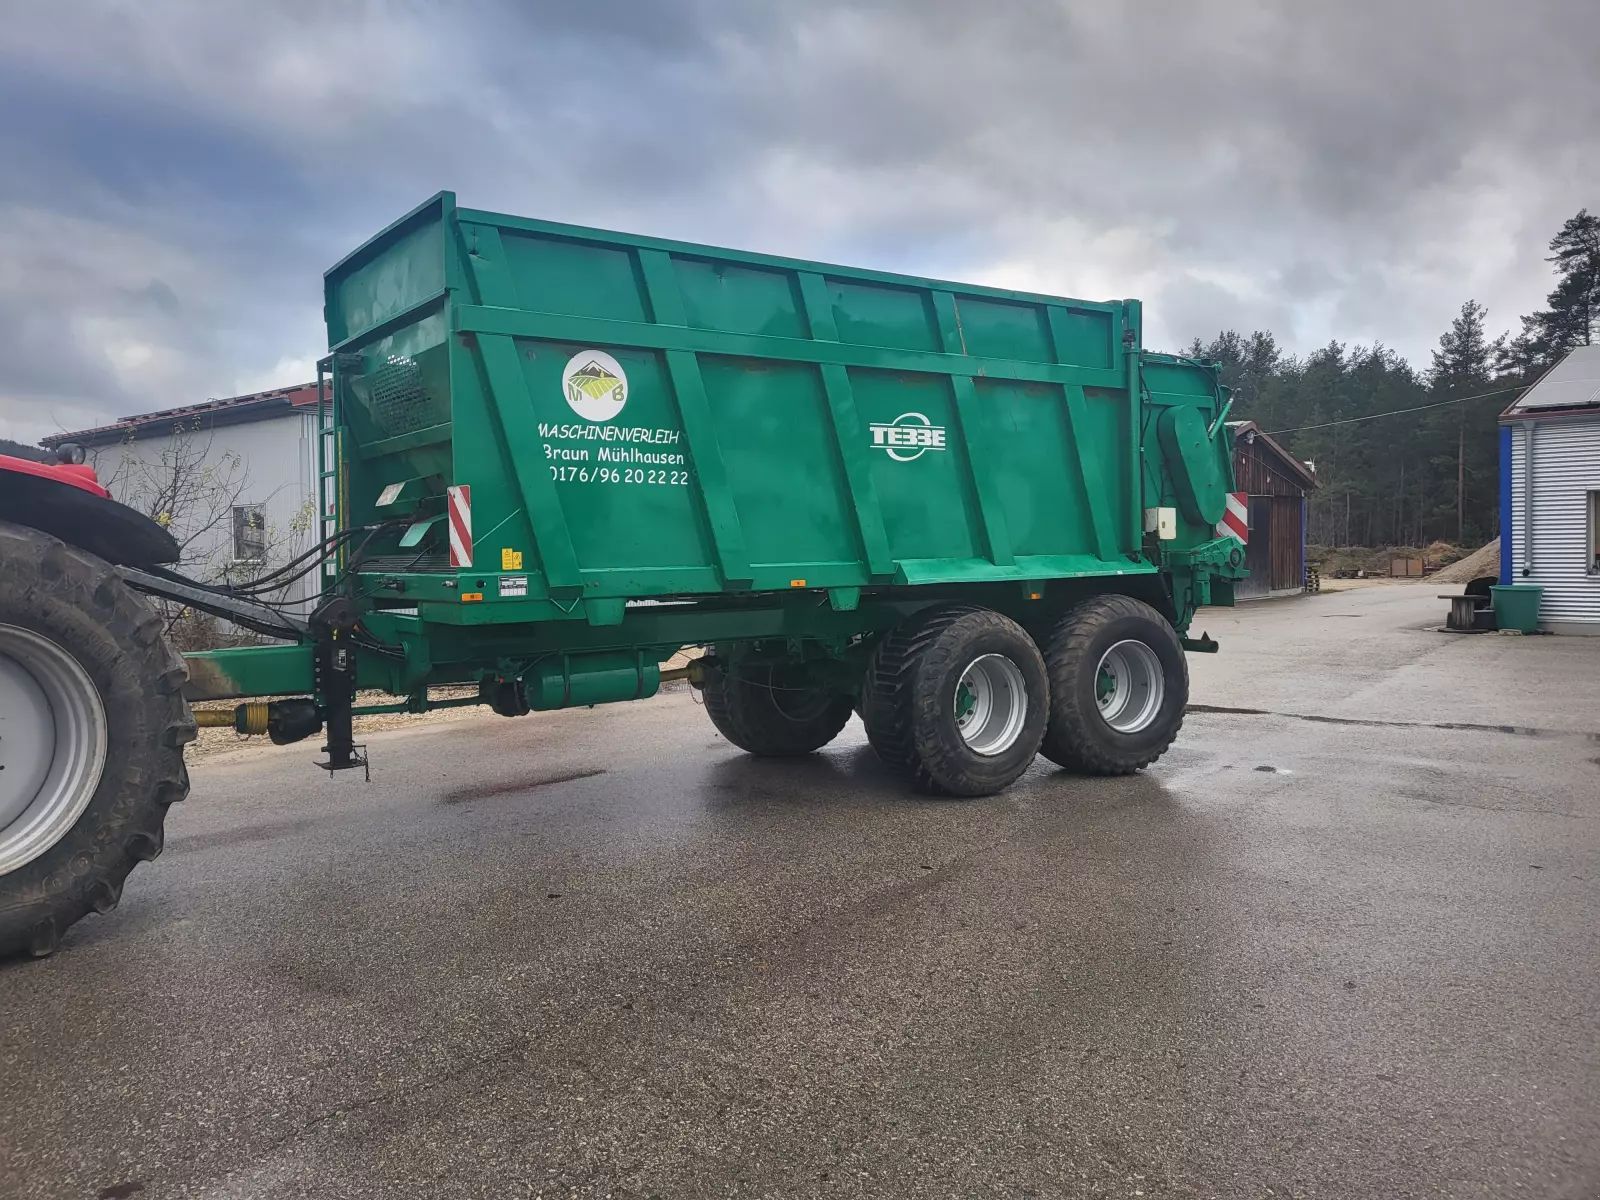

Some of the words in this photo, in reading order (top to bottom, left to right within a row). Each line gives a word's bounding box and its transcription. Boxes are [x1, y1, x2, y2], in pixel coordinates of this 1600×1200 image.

[612, 383, 624, 401] B
[538, 422, 680, 444] MASCHINENVERLEIH
[869, 426, 946, 447] TEBBE
[597, 446, 684, 465] Mühlhausen
[624, 468, 644, 484] 20
[647, 469, 666, 484] 22
[670, 470, 688, 485] 22
